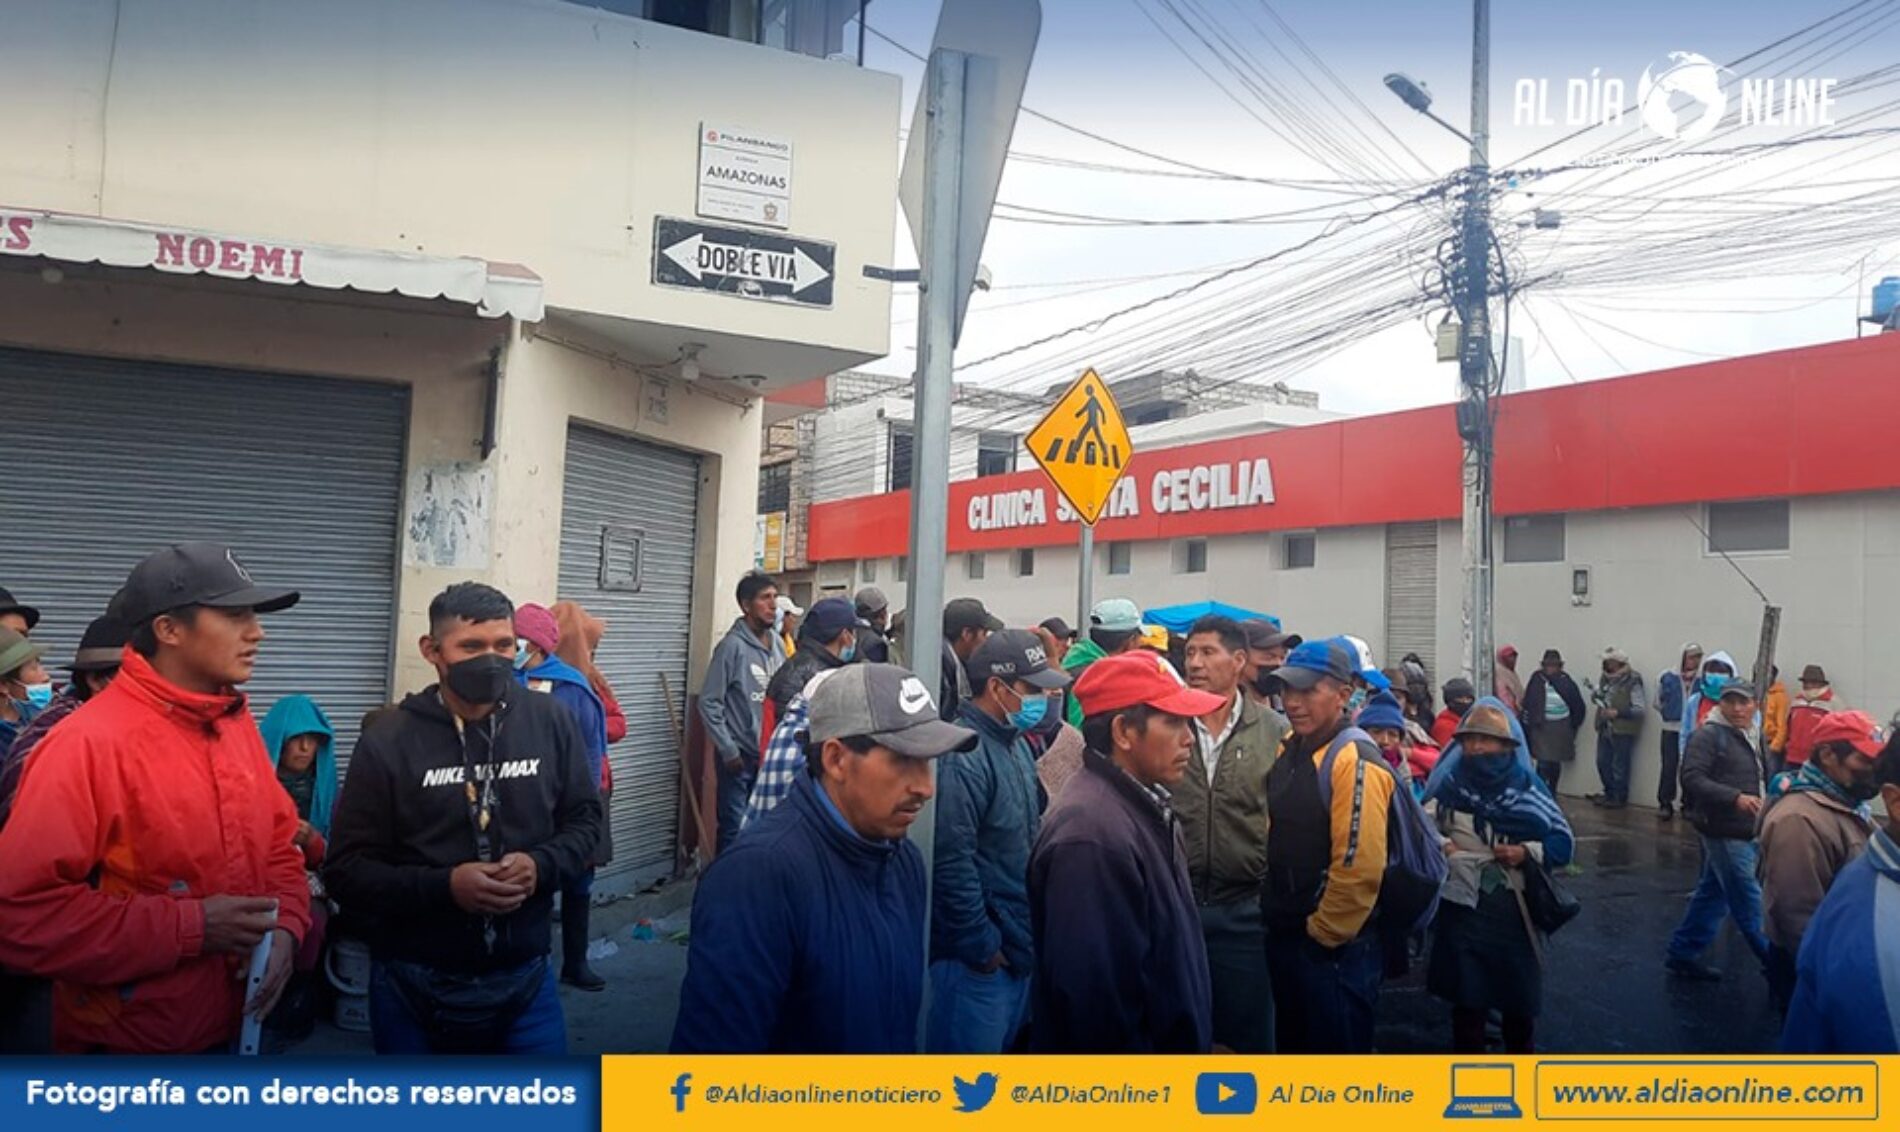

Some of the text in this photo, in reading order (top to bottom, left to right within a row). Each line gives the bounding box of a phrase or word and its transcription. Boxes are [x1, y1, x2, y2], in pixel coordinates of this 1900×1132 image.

[706, 165, 786, 189] AMAZONAS
[0, 216, 304, 279] S NOEMI
[698, 244, 798, 281] DOBLE VIA
[968, 488, 1046, 530] CLINICA
[1152, 458, 1275, 513] CECILIA
[422, 766, 465, 787] NIKE
[498, 757, 540, 779] MAX
